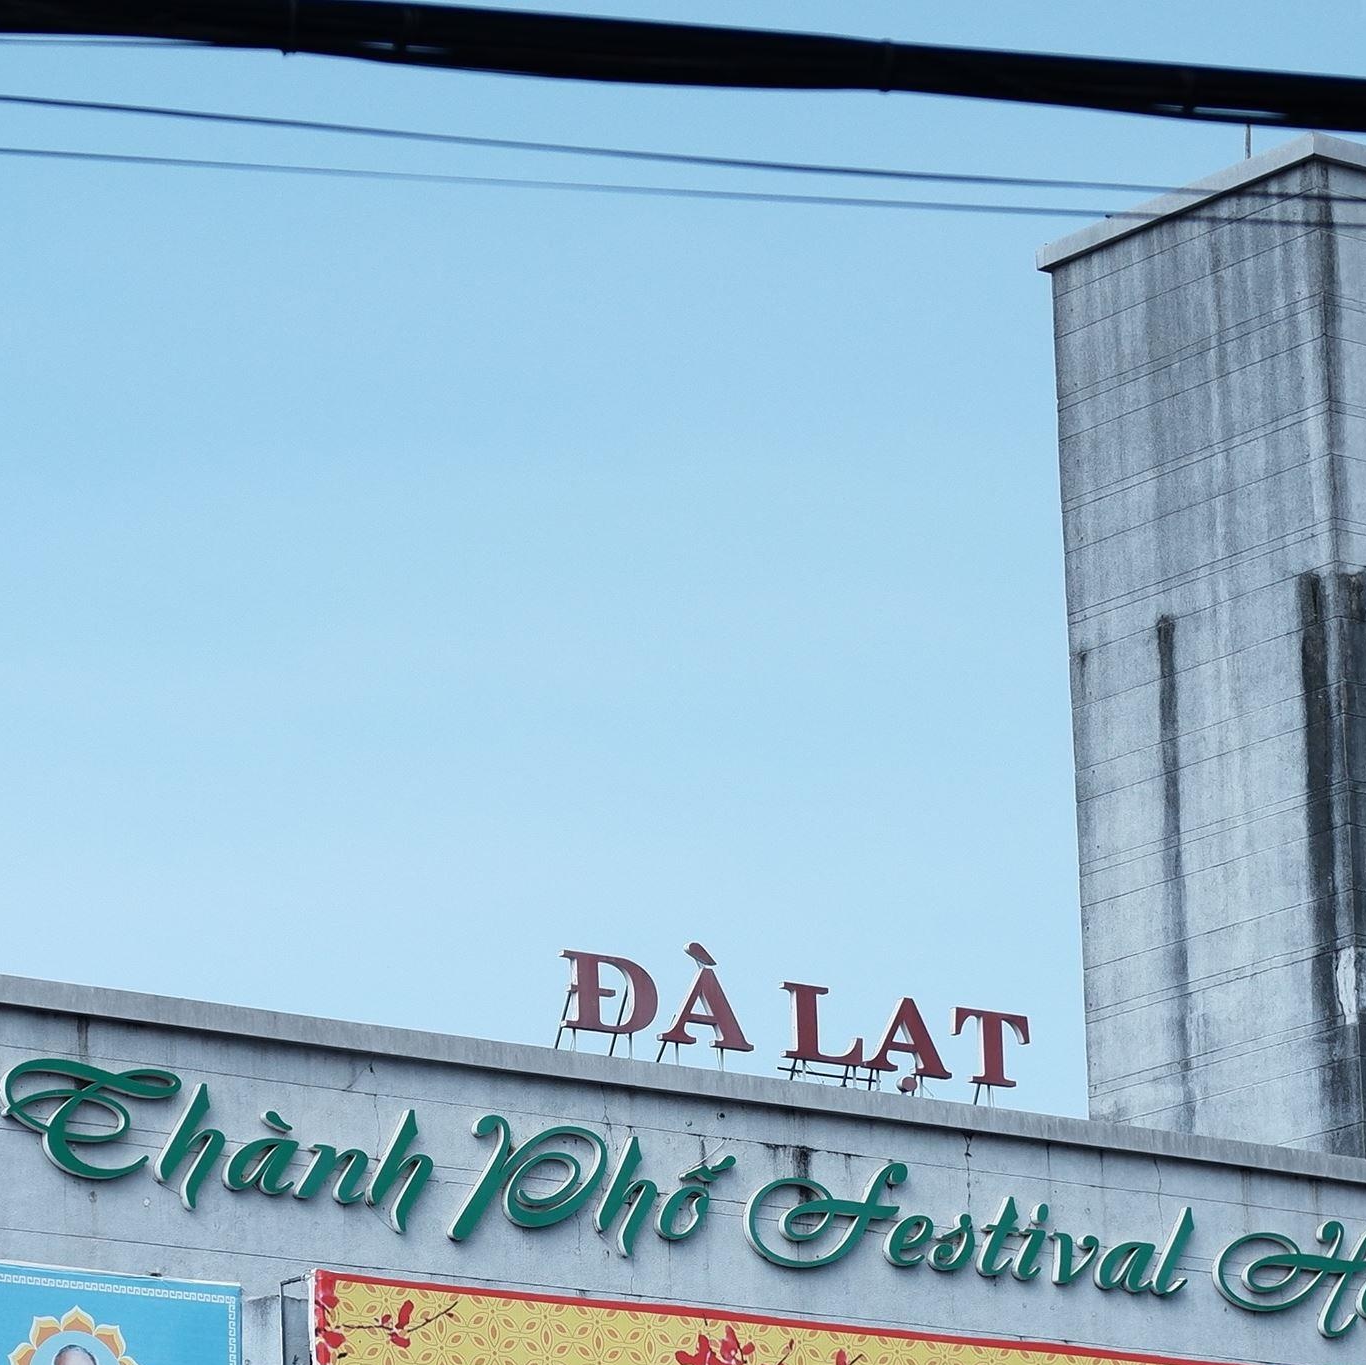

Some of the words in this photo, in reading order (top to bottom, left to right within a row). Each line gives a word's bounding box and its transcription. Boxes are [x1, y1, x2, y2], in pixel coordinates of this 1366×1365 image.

[559, 942, 754, 1052] ĐÀ
[779, 982, 1030, 1095] LẠT
[0, 1058, 433, 1234] Thành
[447, 1114, 736, 1259] Phố
[743, 1161, 1193, 1295] Festival
